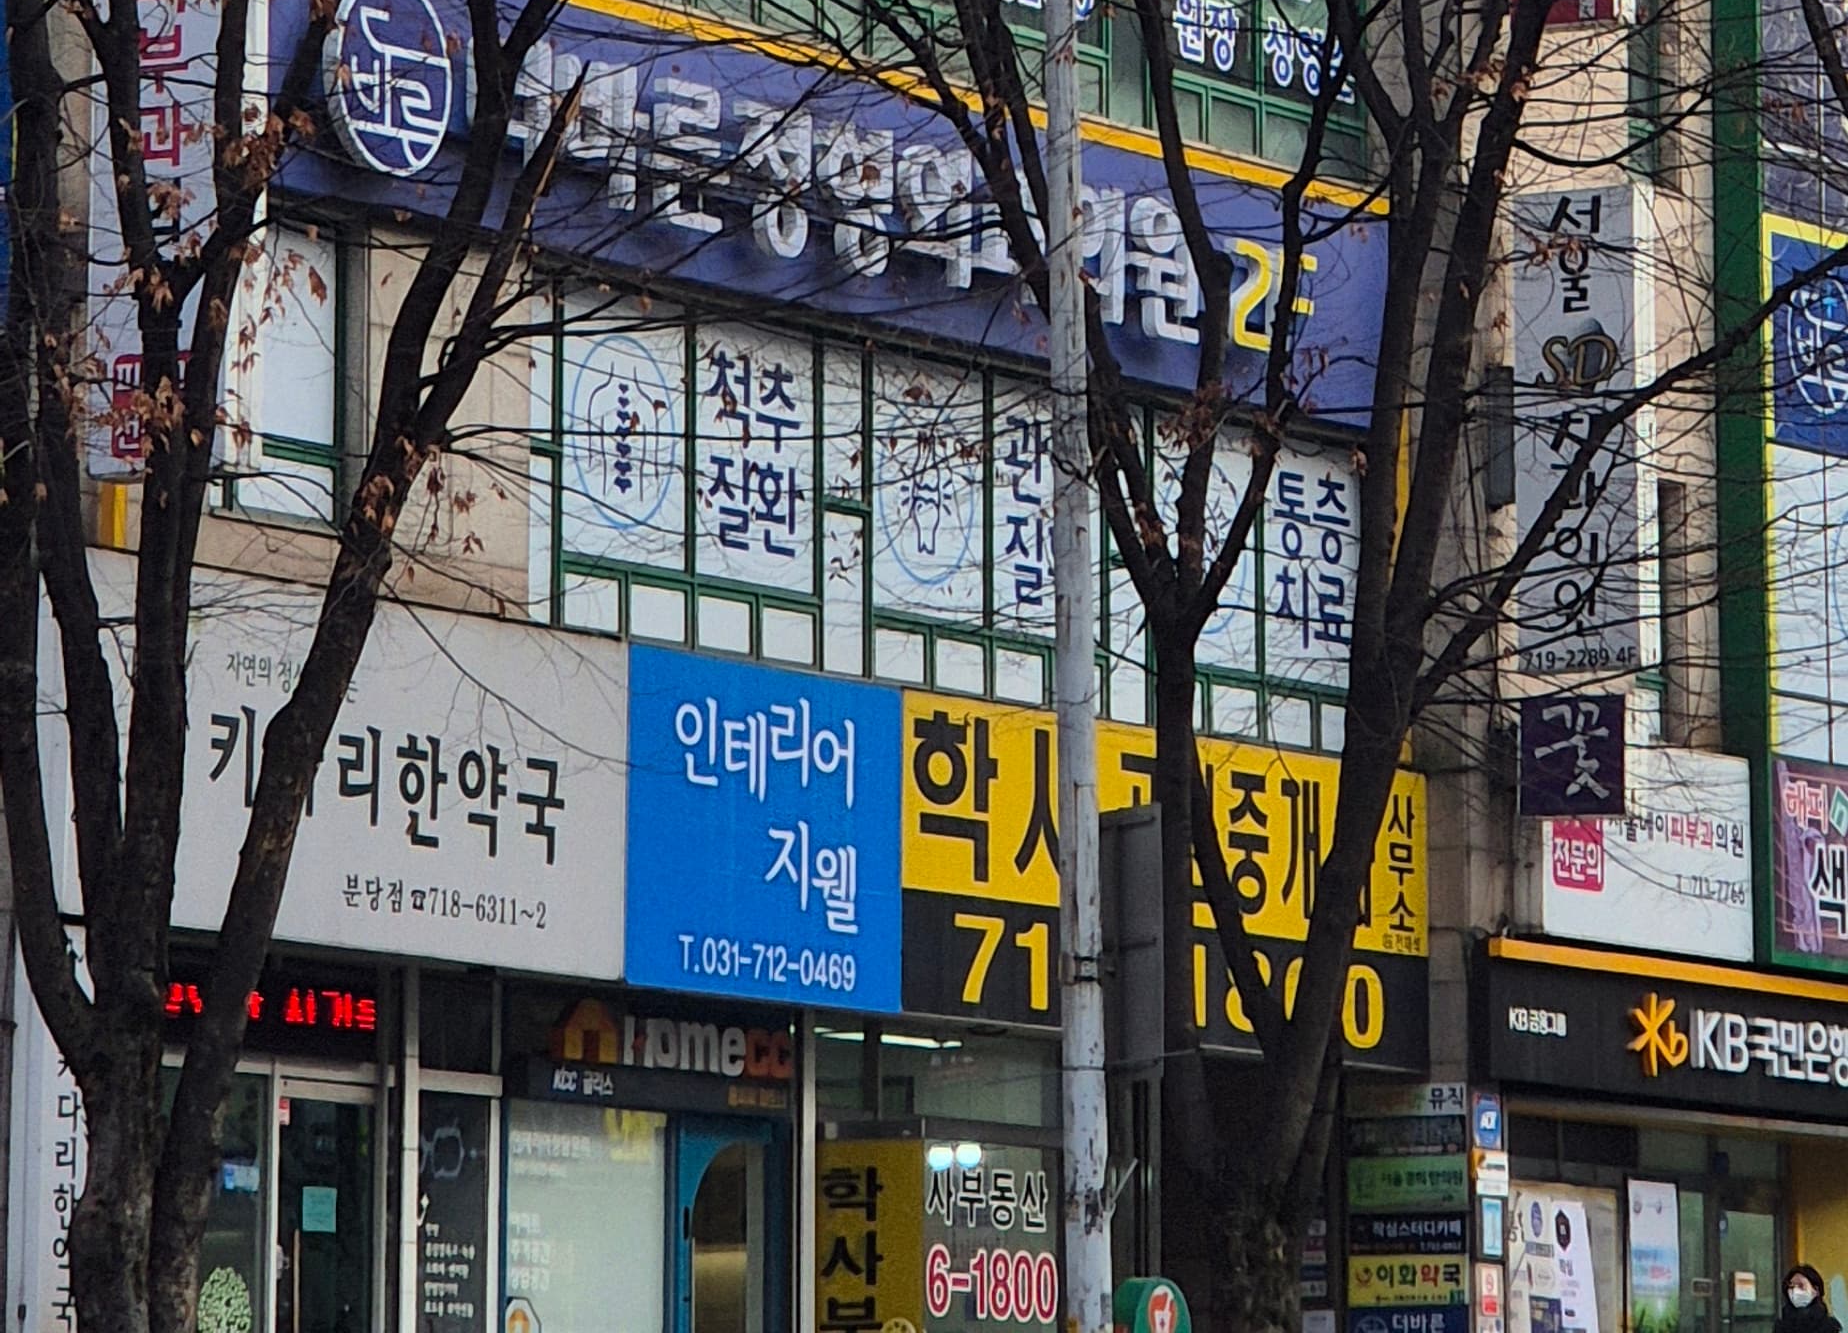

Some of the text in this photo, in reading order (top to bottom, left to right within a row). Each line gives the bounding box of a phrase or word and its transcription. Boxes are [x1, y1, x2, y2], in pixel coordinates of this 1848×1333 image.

[1549, 193, 1602, 315] 서울
[707, 350, 801, 455] 척추
[707, 454, 798, 559] 질환
[1272, 469, 1353, 568] 통증
[1274, 565, 1353, 650] 치료
[226, 650, 272, 688] 자연의
[1615, 644, 1638, 666] 4F
[209, 705, 565, 865] 키리한약국
[674, 696, 856, 810] 인테리어
[341, 873, 404, 914] 분당점
[765, 820, 859, 935] 지웰
[1387, 793, 1416, 933] 사무소
[1552, 836, 1603, 885] 전문의
[678, 934, 857, 992] T.031-712-0469
[1428, 1086, 1465, 1112] 뮤직
[925, 1168, 1049, 1234] 사부동산
[925, 1242, 1059, 1325] 6-1800
[1376, 1262, 1462, 1288] 이화약국
